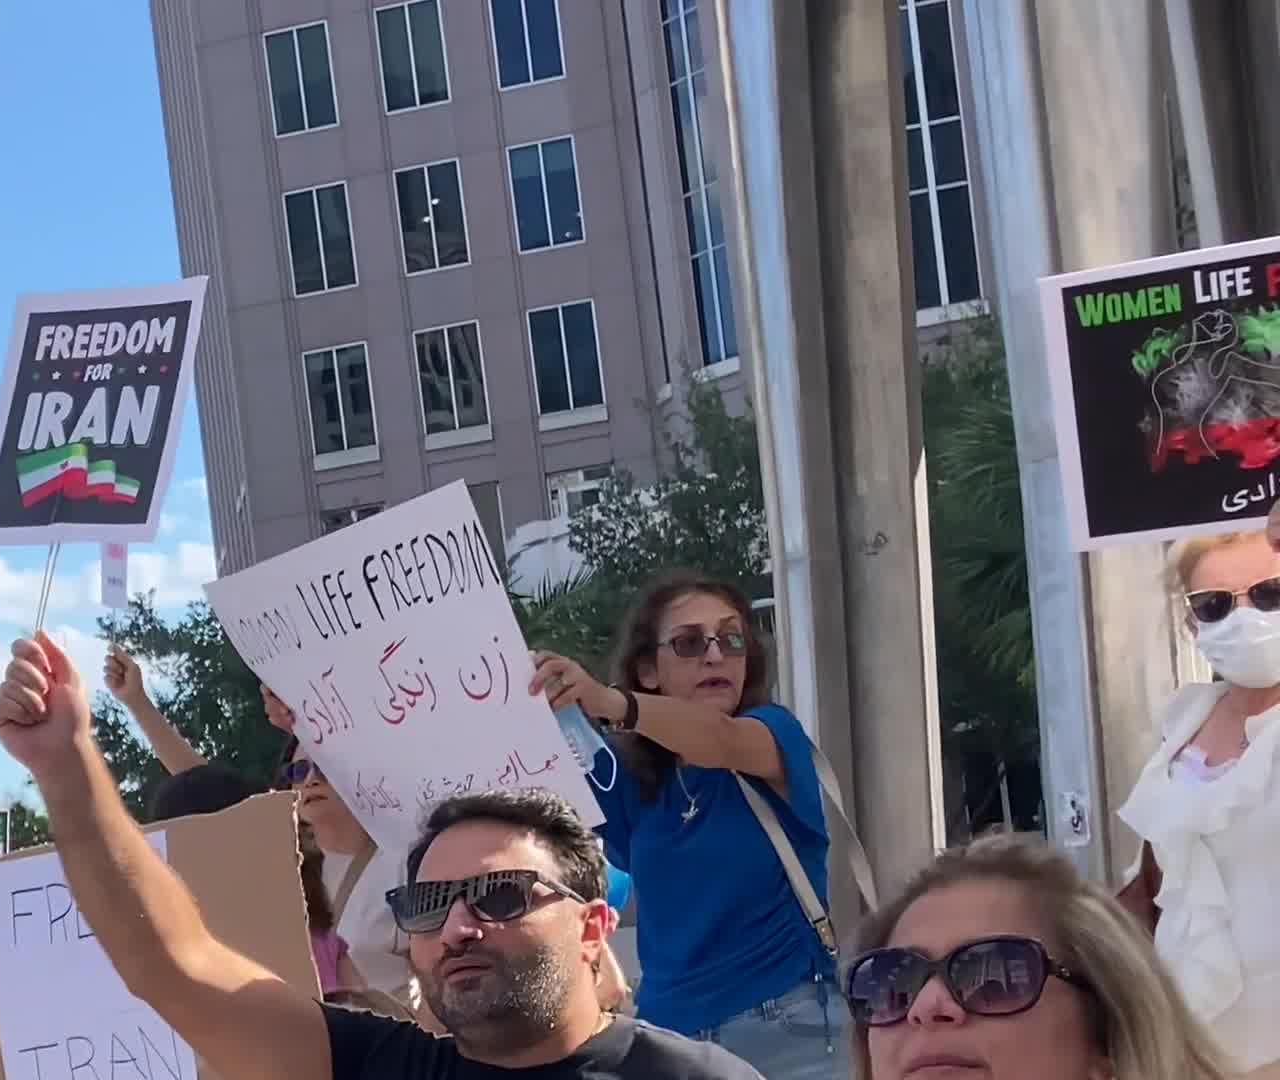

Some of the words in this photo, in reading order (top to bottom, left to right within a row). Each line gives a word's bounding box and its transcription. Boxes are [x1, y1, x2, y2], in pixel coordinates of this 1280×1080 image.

[1193, 266, 1253, 303] LIFE
[34, 316, 176, 361] FREEDOM
[83, 364, 113, 383] FOR
[17, 385, 160, 450] IRAN
[295, 569, 361, 640] LIFE
[361, 520, 500, 621] FREEDOM
[458, 636, 509, 704] زن
